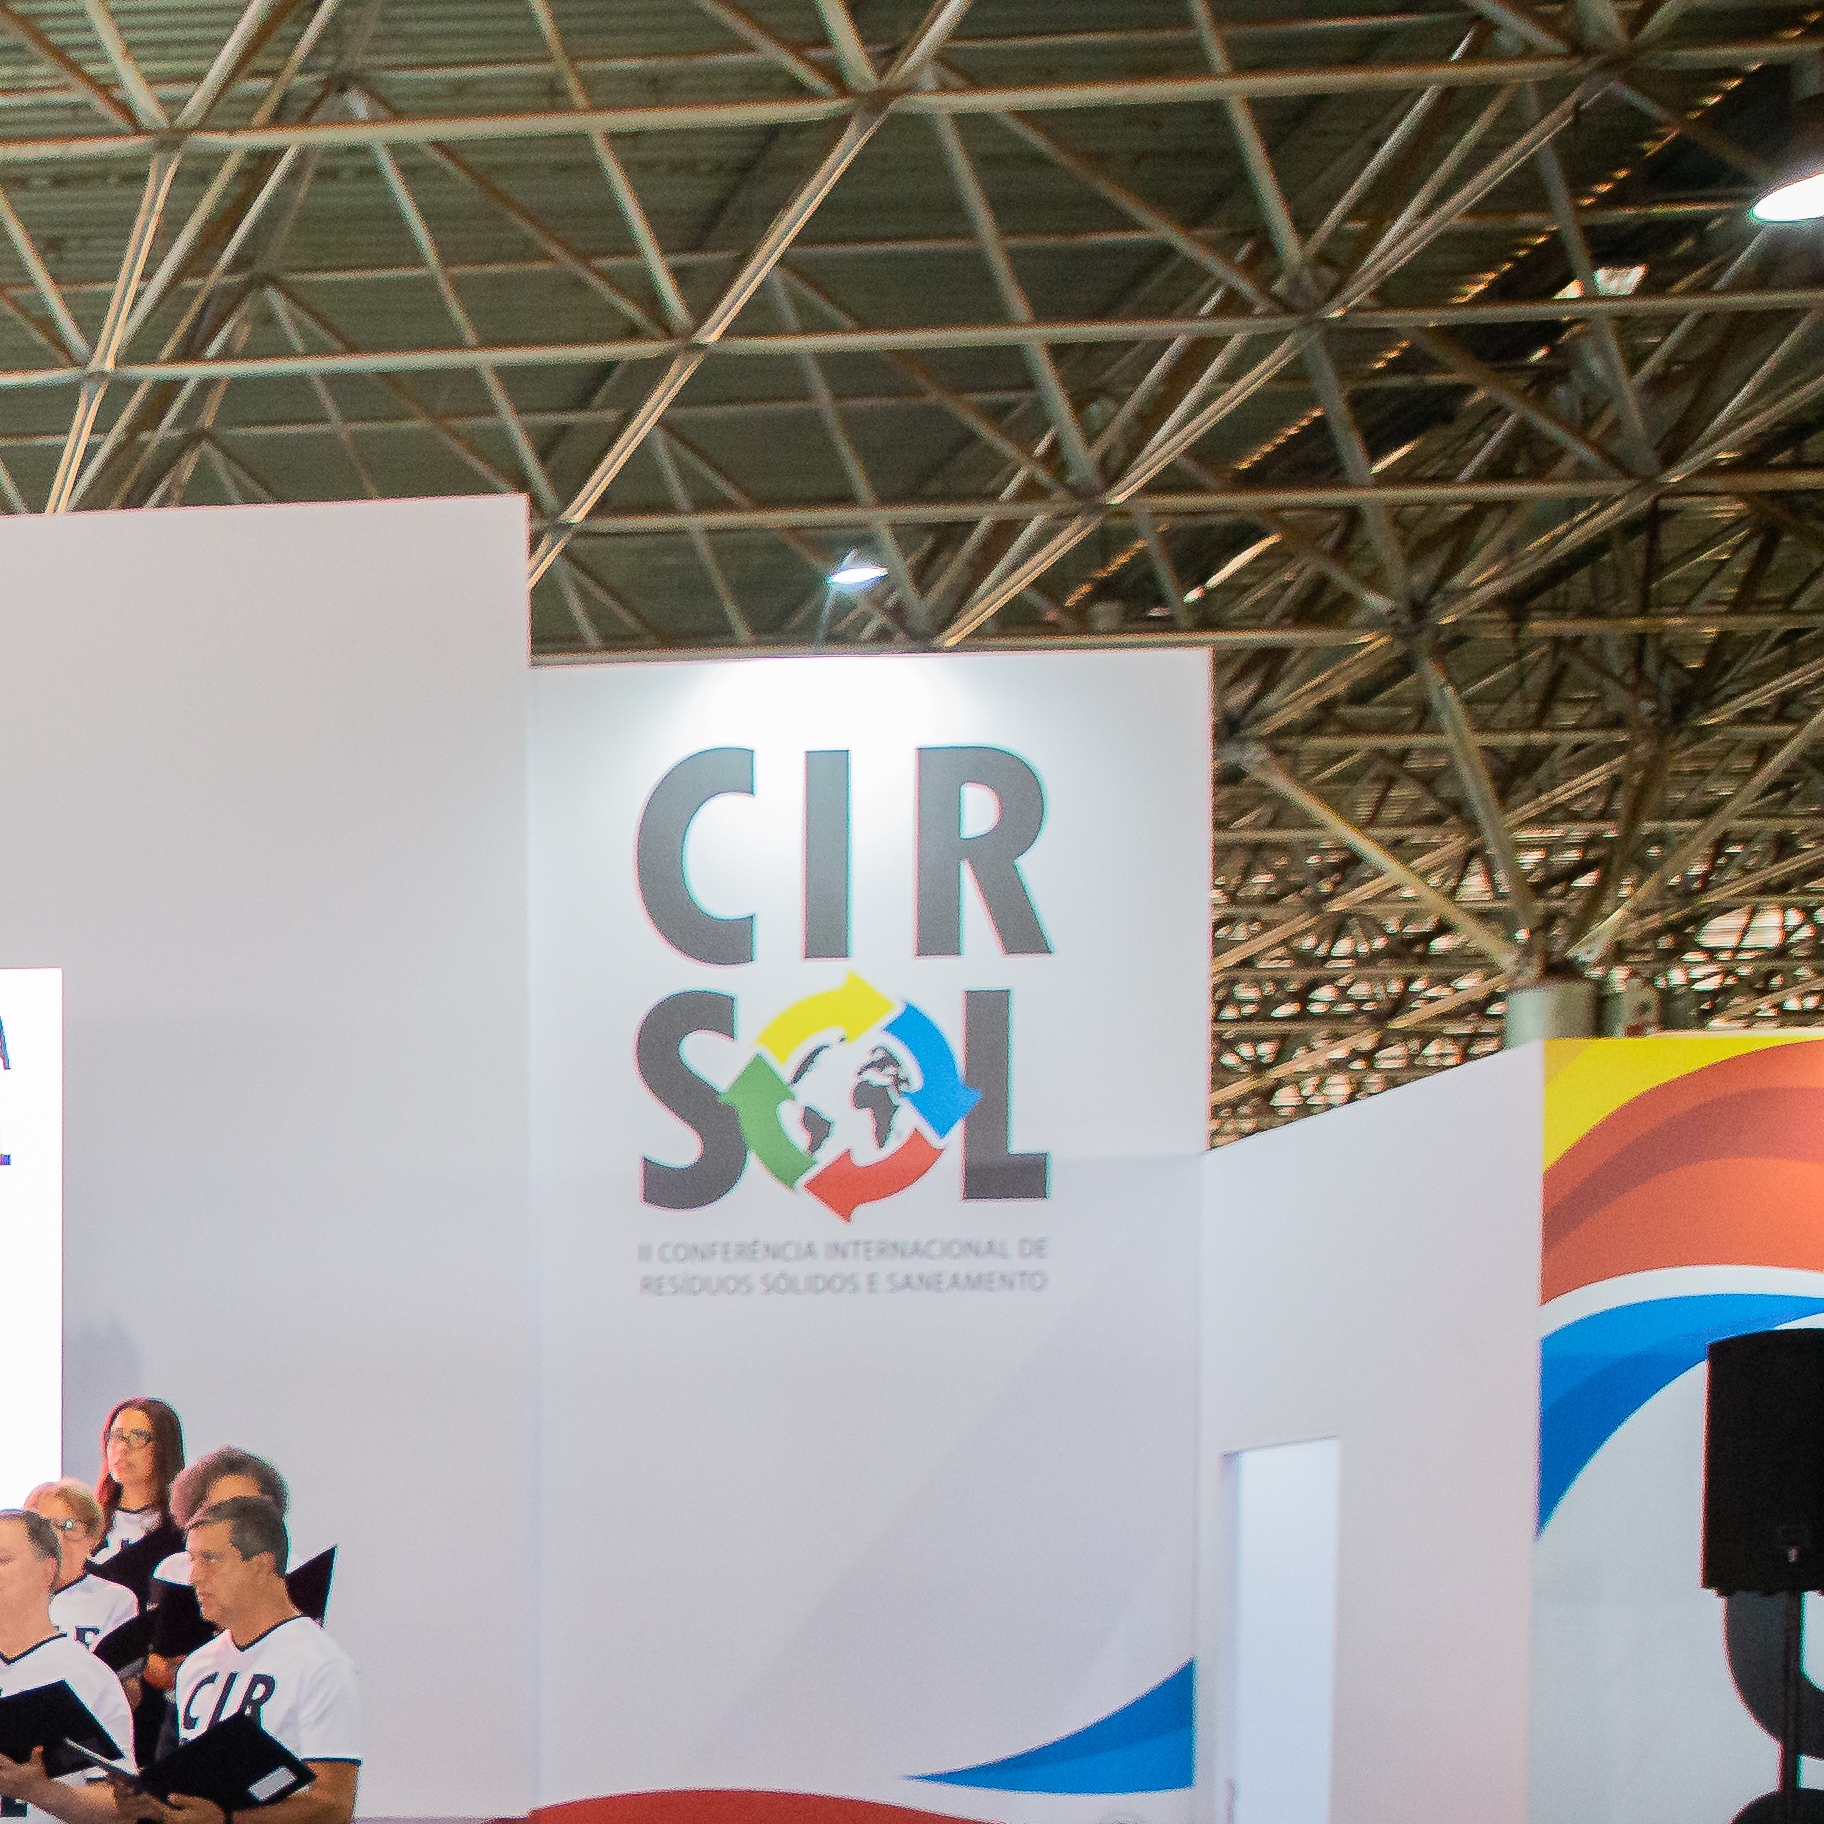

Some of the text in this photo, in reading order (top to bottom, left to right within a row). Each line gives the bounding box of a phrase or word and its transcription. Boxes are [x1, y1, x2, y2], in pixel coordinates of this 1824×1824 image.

[634, 746, 1053, 966] CIR
[634, 970, 1050, 1223] SOL
[657, 1237, 818, 1263] CONFERÊNCIA
[824, 1238, 1011, 1261] INTERNACIONAL
[1018, 1237, 1048, 1260] DE
[640, 1269, 1049, 1296] RESÍDUOS SÓLIDOS E SANEAMENTO
[183, 1671, 276, 1730] CIR
